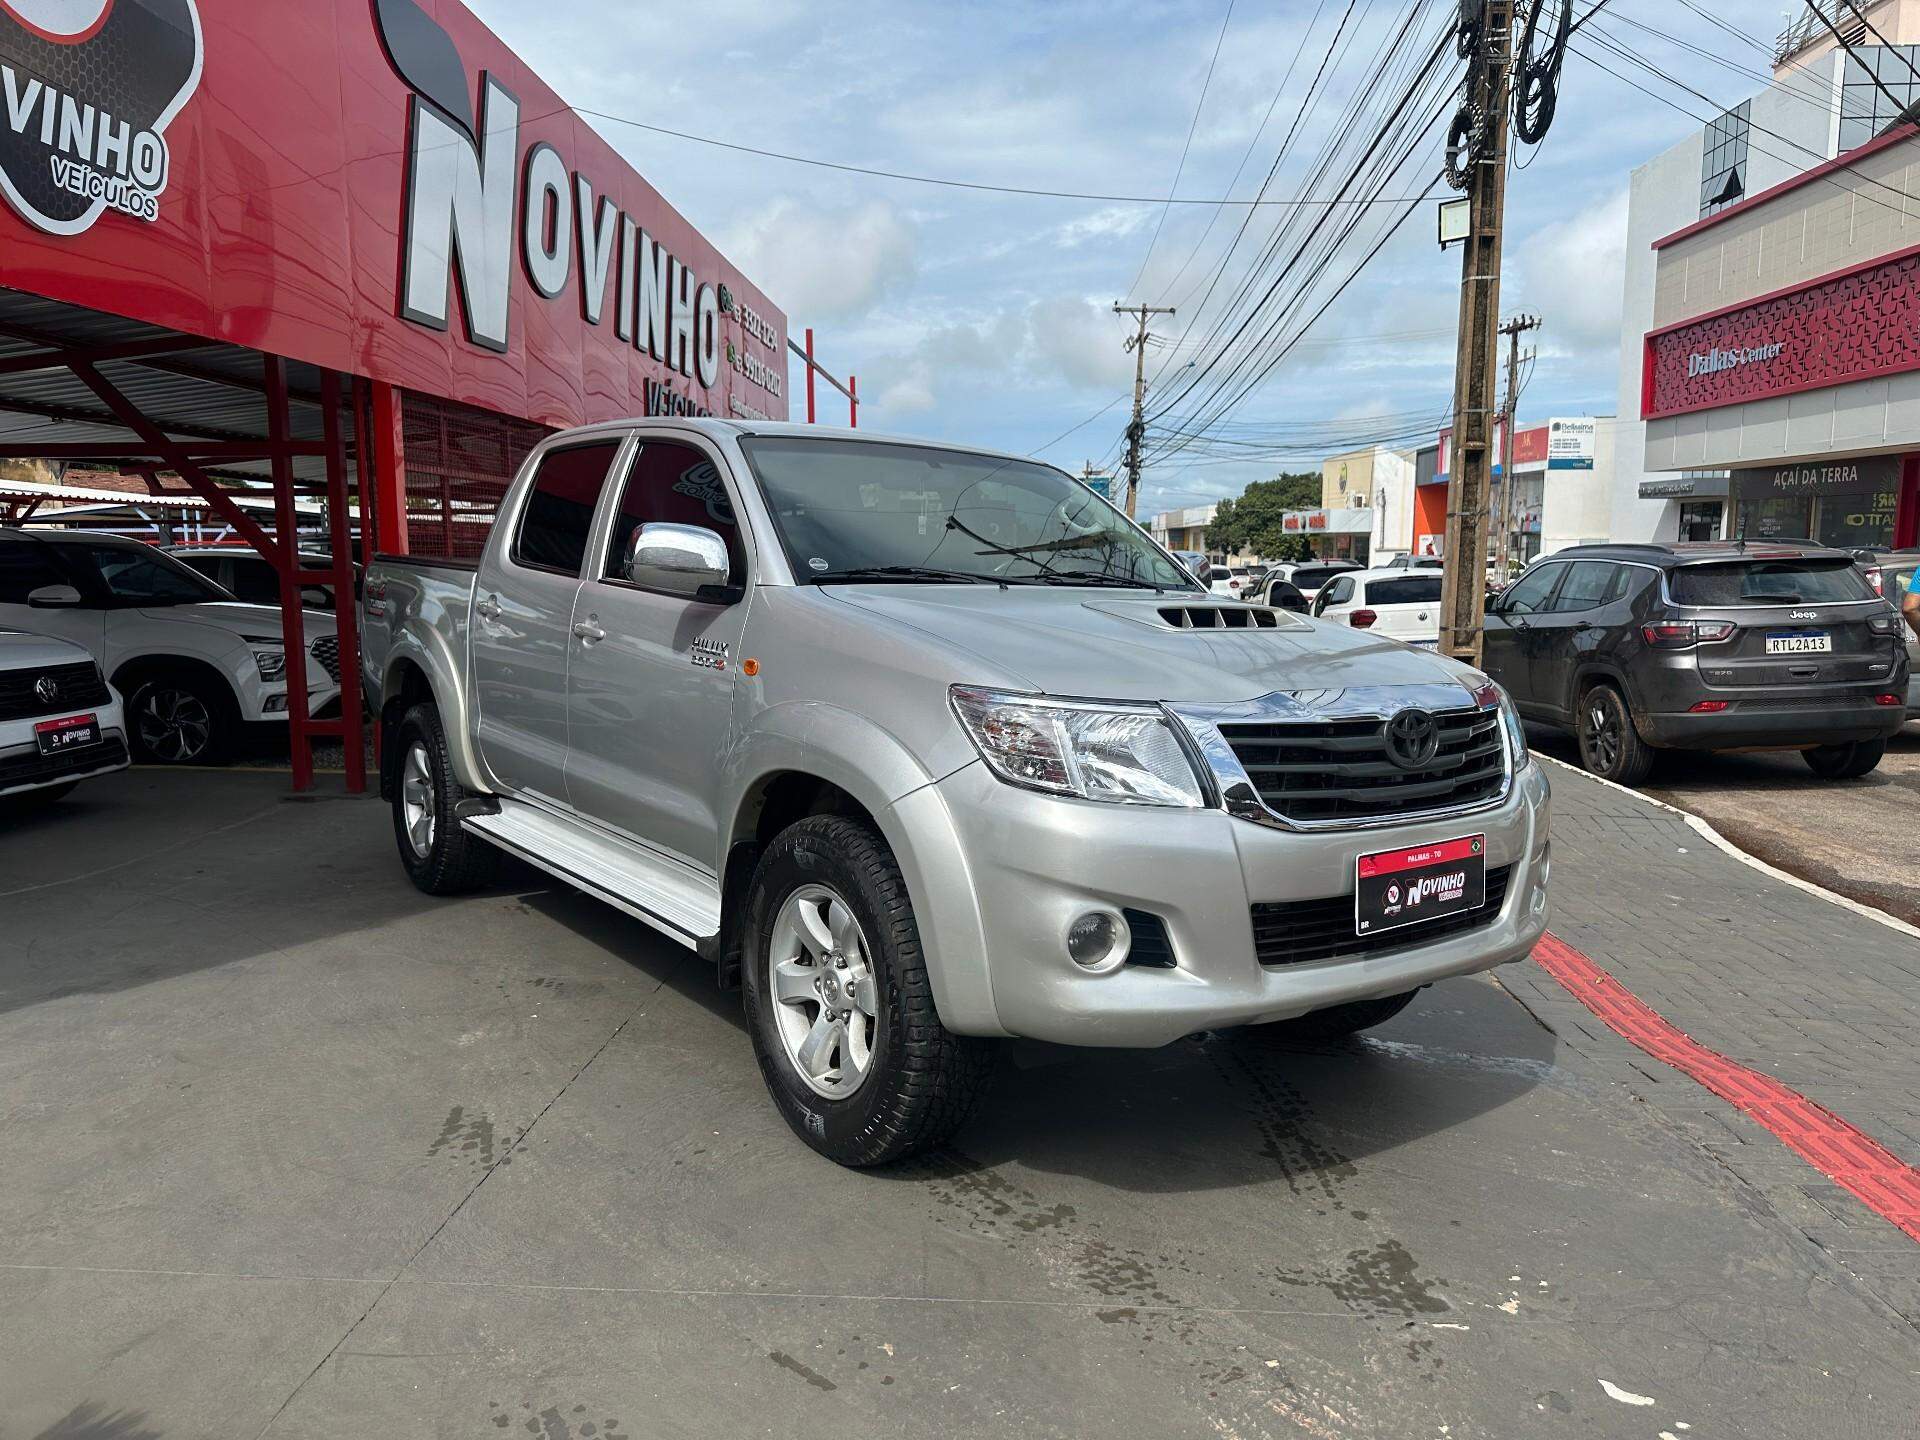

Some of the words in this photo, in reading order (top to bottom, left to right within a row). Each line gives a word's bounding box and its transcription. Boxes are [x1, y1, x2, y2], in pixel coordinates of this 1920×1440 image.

[51, 156, 157, 220] VEÍCULOS
[397, 70, 720, 390] NOVINHO
[1688, 347, 1737, 377] Dallas
[1740, 342, 1785, 365] Center
[1773, 467, 1800, 490] AÇAÍ
[1801, 469, 1817, 486] DA
[1821, 465, 1858, 483] TERRA
[1789, 610, 1817, 620] Jeep
[1773, 638, 1825, 652] RTL2A13
[62, 728, 91, 744] NOVINHO
[1407, 853, 1430, 863] PALMAS
[1406, 872, 1465, 906] NOVINHO
[1360, 920, 1370, 929] BR
